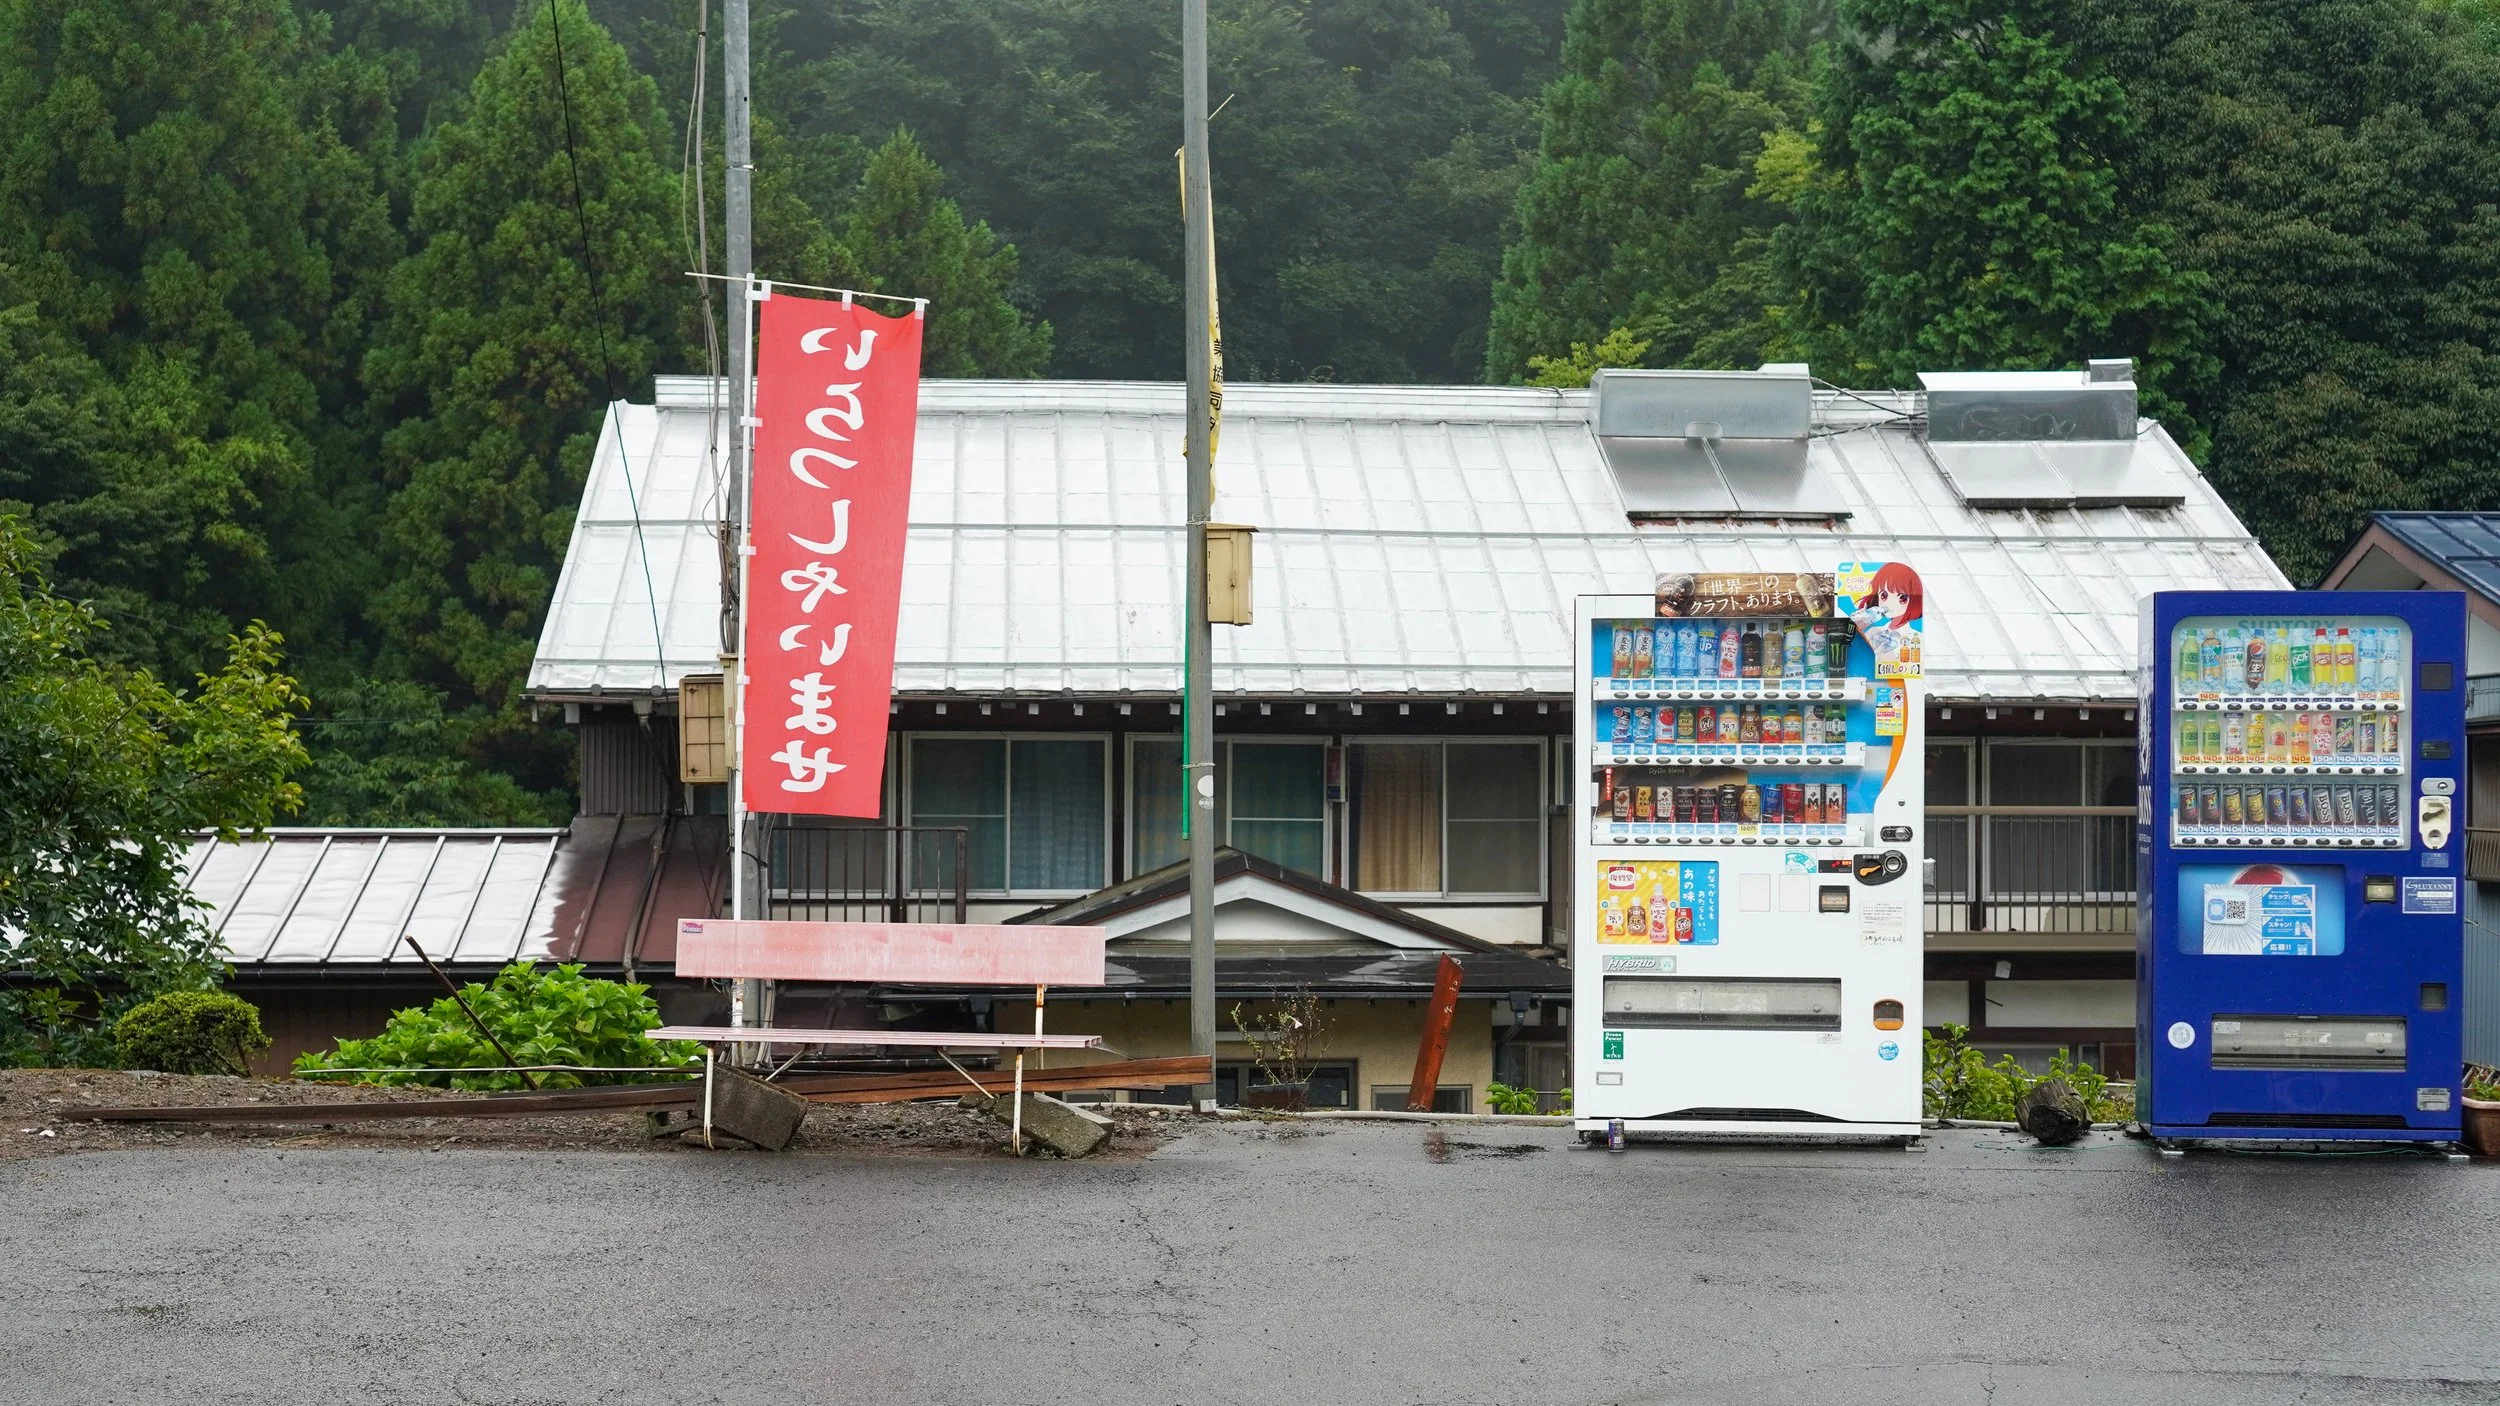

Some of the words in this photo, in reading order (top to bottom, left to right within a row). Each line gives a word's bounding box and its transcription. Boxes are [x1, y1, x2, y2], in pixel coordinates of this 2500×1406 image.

[770, 327, 878, 793] いらっしゃいませ
[1704, 574, 1779, 597] 「世界一」の
[1690, 589, 1800, 615] クラフト、あります。
[2319, 795, 2331, 823] BOSS
[2341, 795, 2354, 823] BOSS
[1683, 868, 1696, 902] あの味
[1606, 959, 1656, 970] HYBRID
